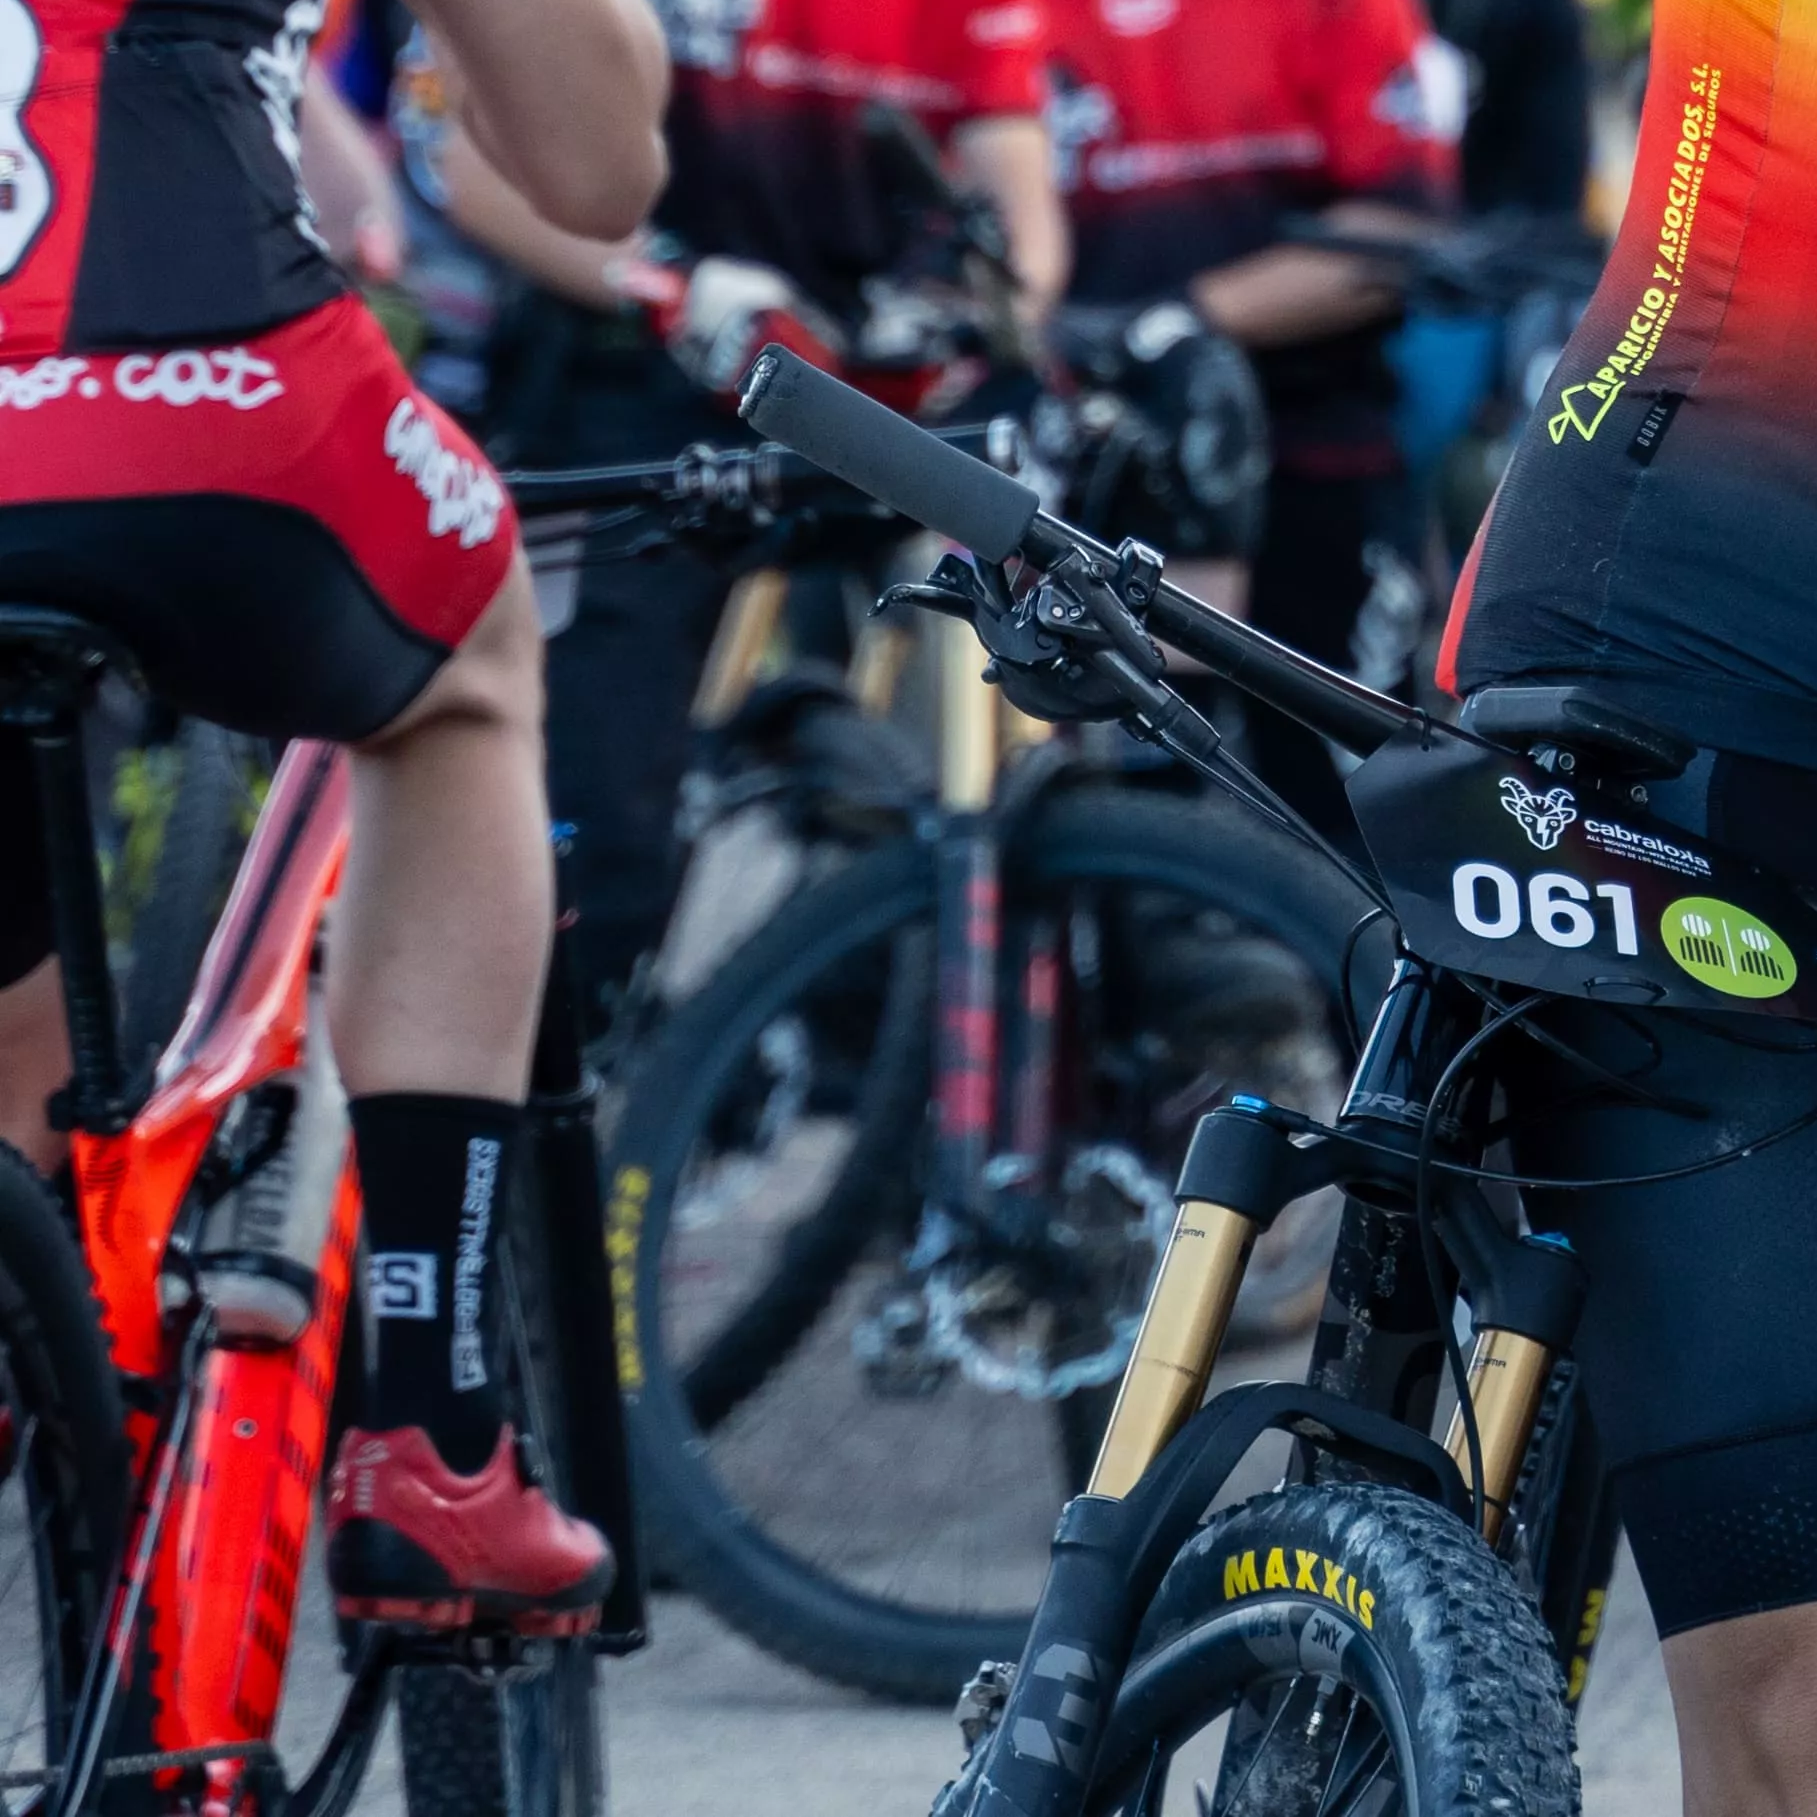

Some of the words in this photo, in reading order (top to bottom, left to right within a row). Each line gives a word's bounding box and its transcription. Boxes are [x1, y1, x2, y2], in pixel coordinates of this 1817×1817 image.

[1698, 142, 1711, 162] DE
[1587, 288, 1665, 399] APARICIO
[1653, 264, 1672, 281] Y
[1453, 863, 1638, 956] 061
[1224, 1547, 1376, 1632] MAXXIS
